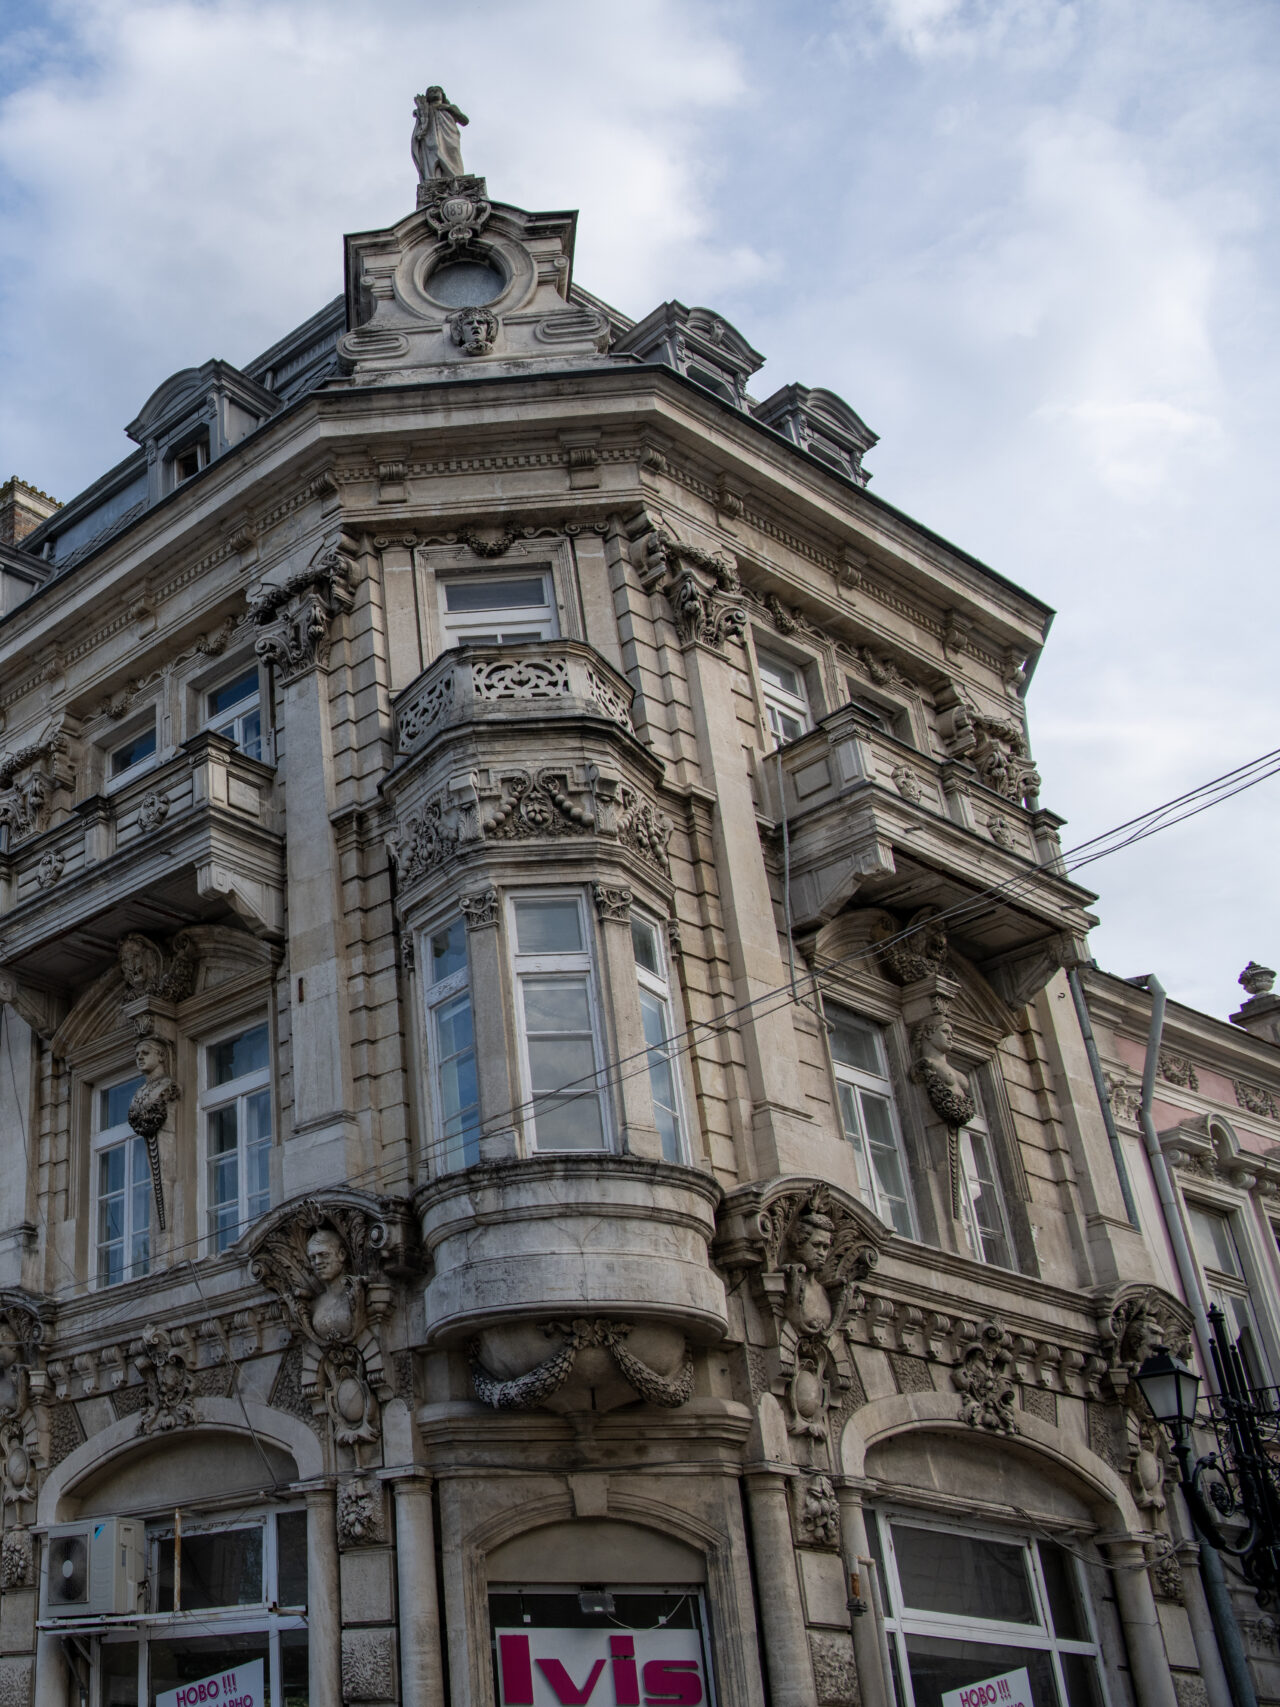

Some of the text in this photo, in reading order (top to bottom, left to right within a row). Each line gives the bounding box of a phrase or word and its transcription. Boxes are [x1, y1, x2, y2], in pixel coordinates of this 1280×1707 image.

[499, 1634, 703, 1706] Ivis
[176, 1680, 220, 1707] НОВО
[959, 1684, 997, 1707] НОВО
